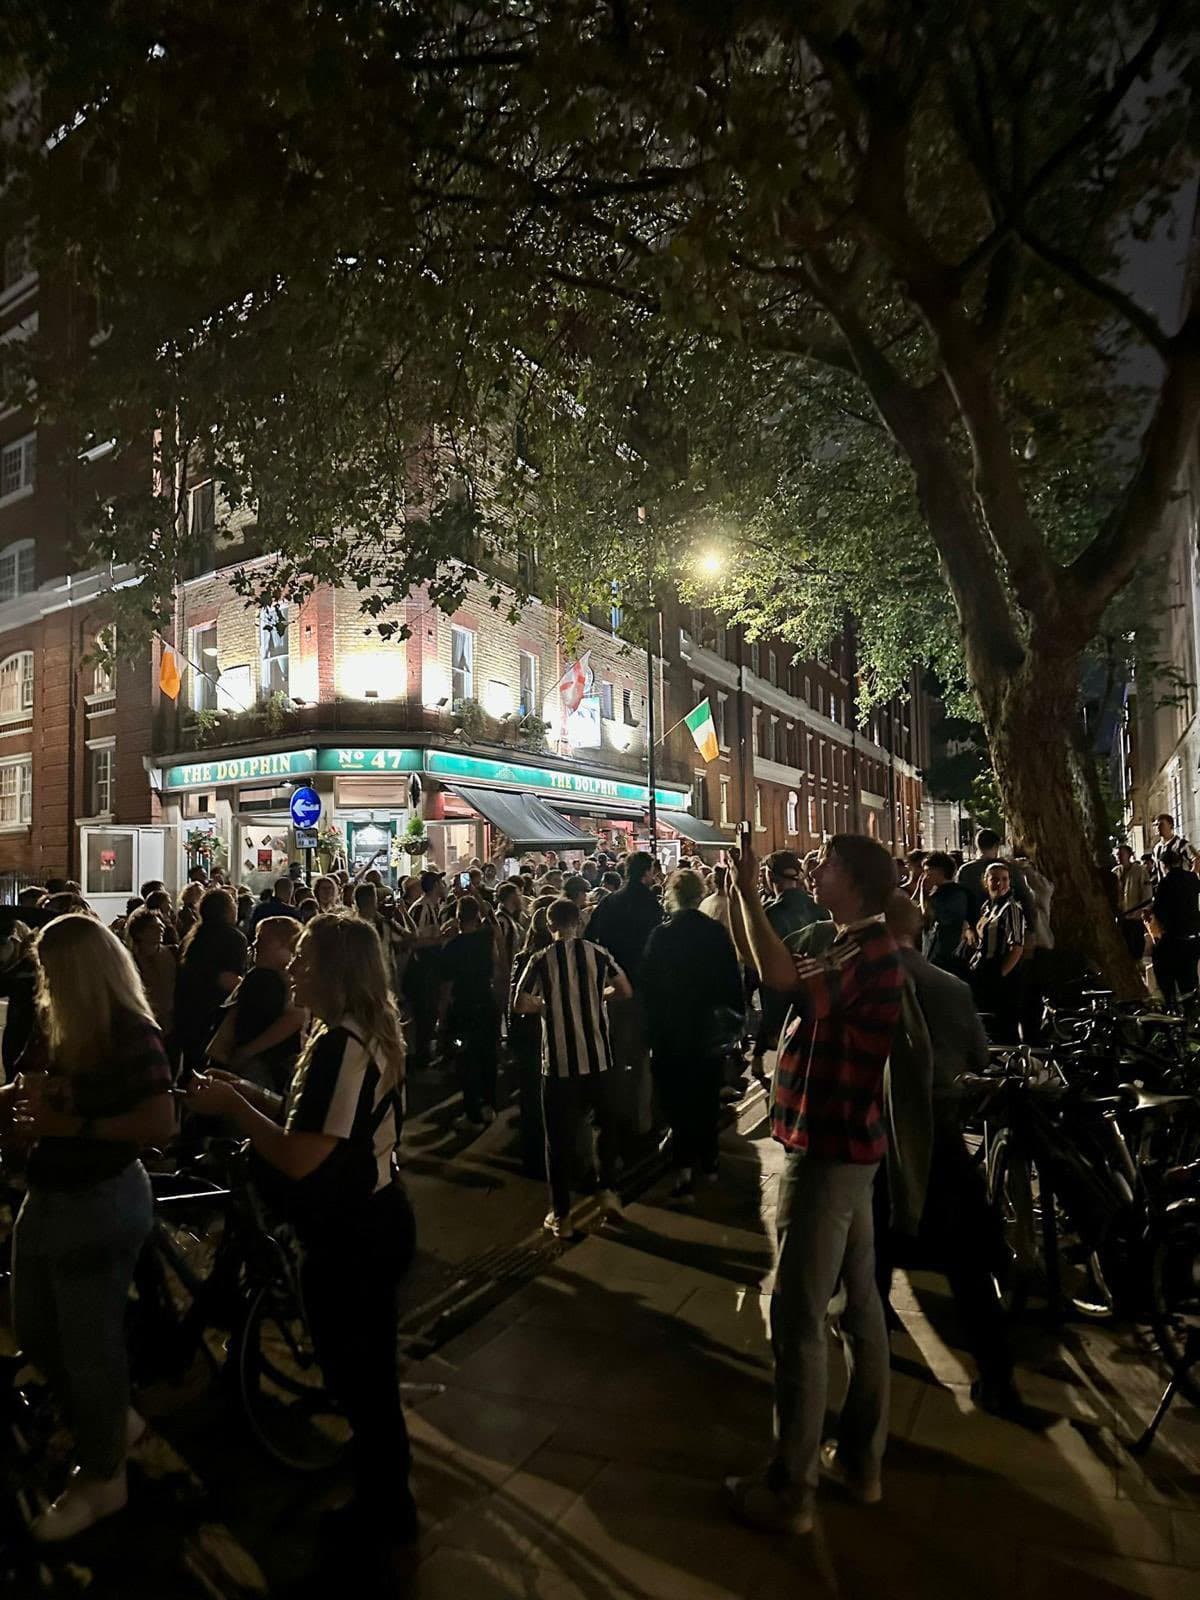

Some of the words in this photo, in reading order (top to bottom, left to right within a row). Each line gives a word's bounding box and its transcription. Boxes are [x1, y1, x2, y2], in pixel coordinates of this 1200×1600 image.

[182, 766, 212, 783] THE
[216, 755, 291, 780] DOLPHIN
[371, 749, 402, 769] 47
[550, 773, 573, 789] THE
[574, 777, 618, 796] DOLPHIN
